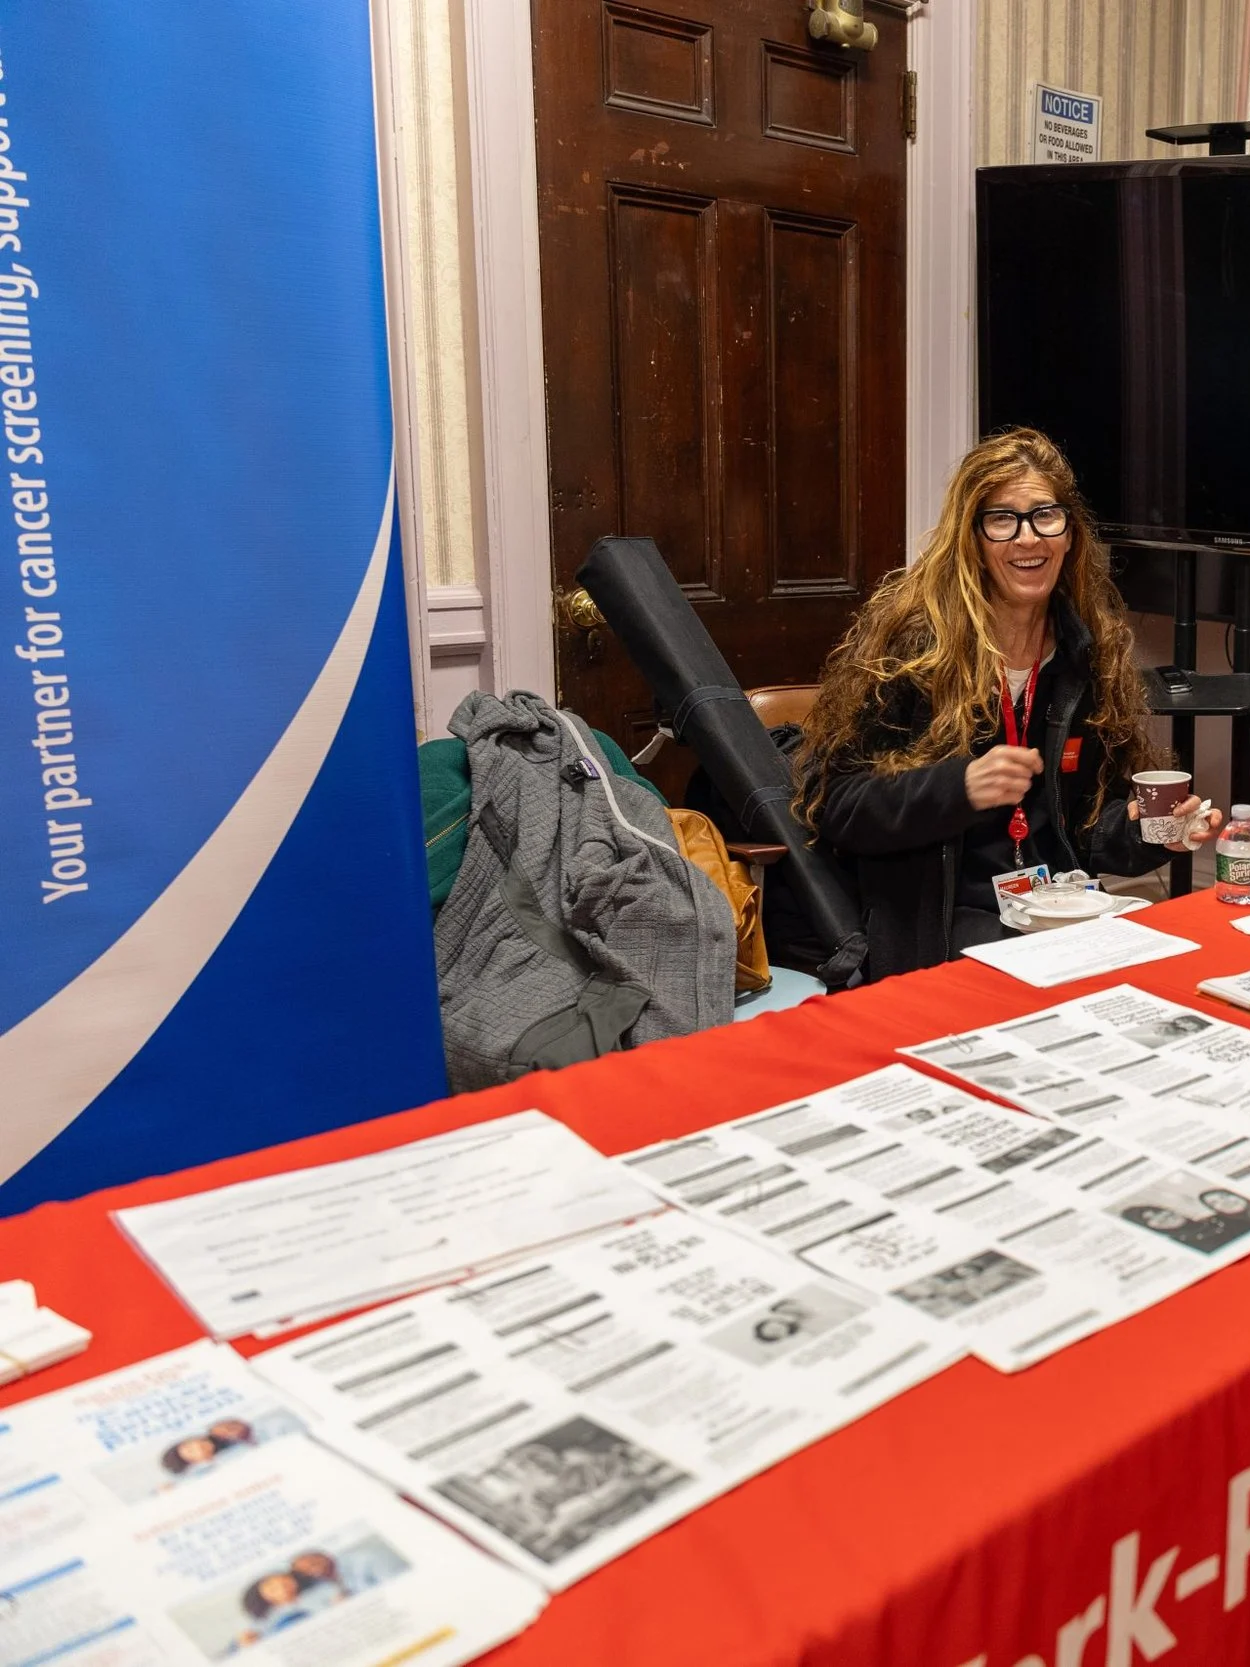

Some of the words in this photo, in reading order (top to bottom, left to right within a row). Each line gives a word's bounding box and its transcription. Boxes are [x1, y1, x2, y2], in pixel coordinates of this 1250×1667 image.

[1045, 94, 1089, 121] NOTICE
[1044, 120, 1053, 131] NO
[1053, 123, 1088, 139] BEVERAGES
[1039, 133, 1048, 144] OR
[1048, 136, 1064, 148] FOOD
[1065, 141, 1093, 154] ALLOWED
[1047, 150, 1053, 160] IN
[10, 472, 58, 599] cancer
[1214, 536, 1243, 545] SAMSUNG
[14, 605, 65, 664] for
[31, 668, 93, 812] partner
[41, 819, 89, 904] Your
